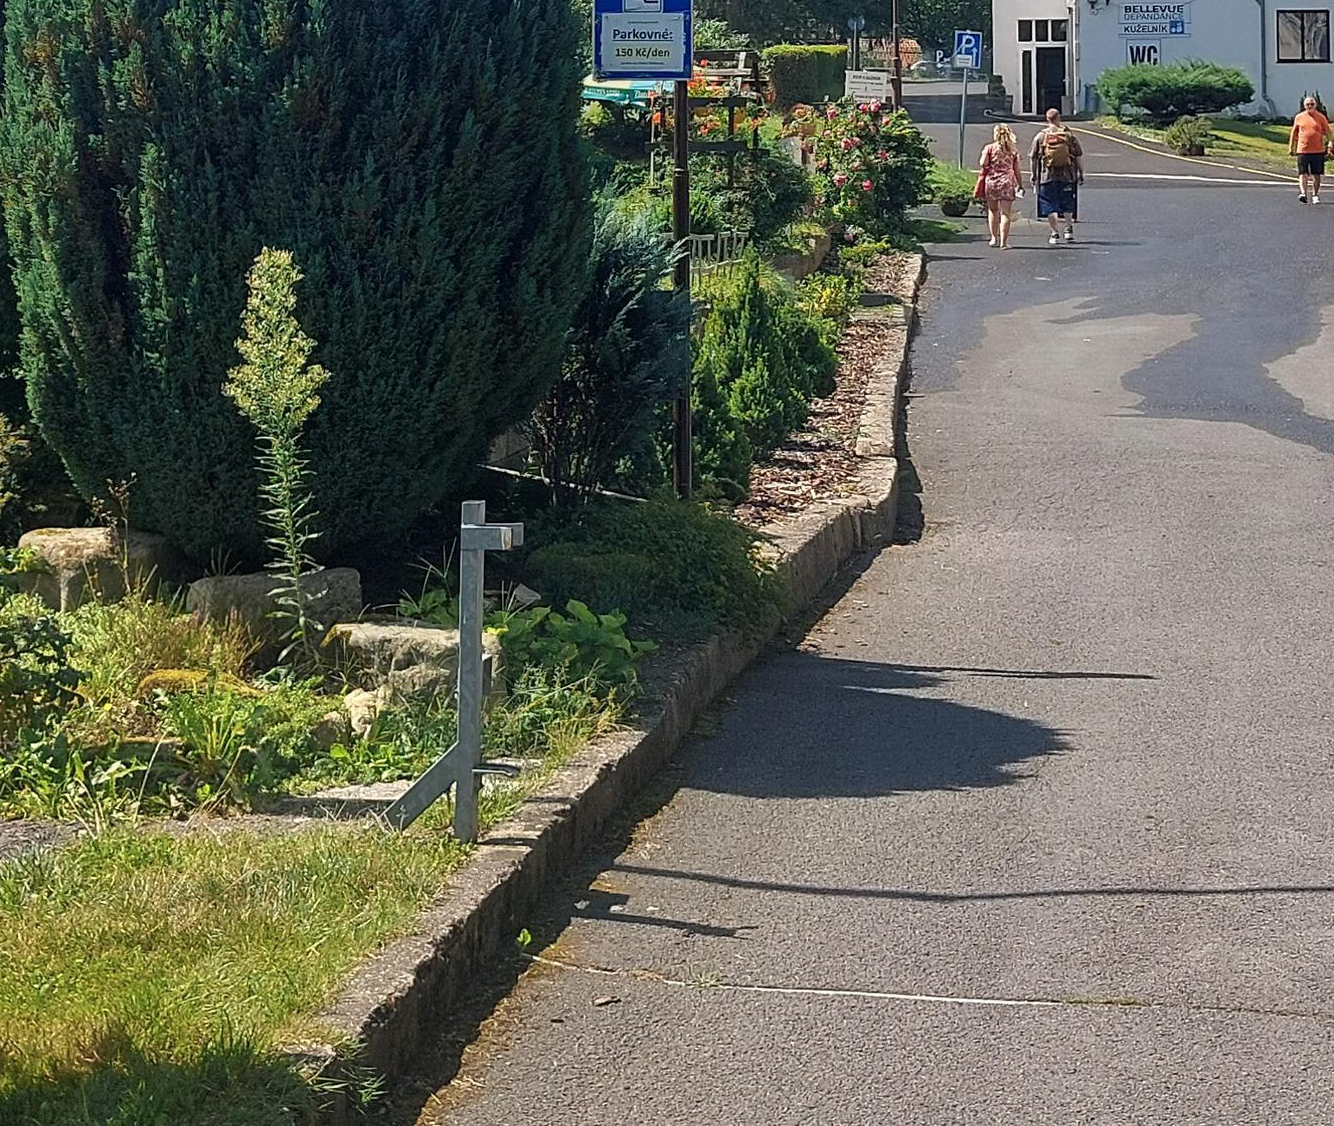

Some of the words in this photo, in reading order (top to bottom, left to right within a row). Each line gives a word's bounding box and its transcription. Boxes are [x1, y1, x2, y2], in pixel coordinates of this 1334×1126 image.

[1124, 5, 1184, 13] BELLEVUE
[613, 28, 674, 39] Parkovné:
[1124, 24, 1168, 33] KUŽELNÍK
[962, 35, 975, 54] P
[615, 48, 633, 57] 150
[635, 47, 670, 59] Kč/den
[1129, 45, 1158, 67] WC
